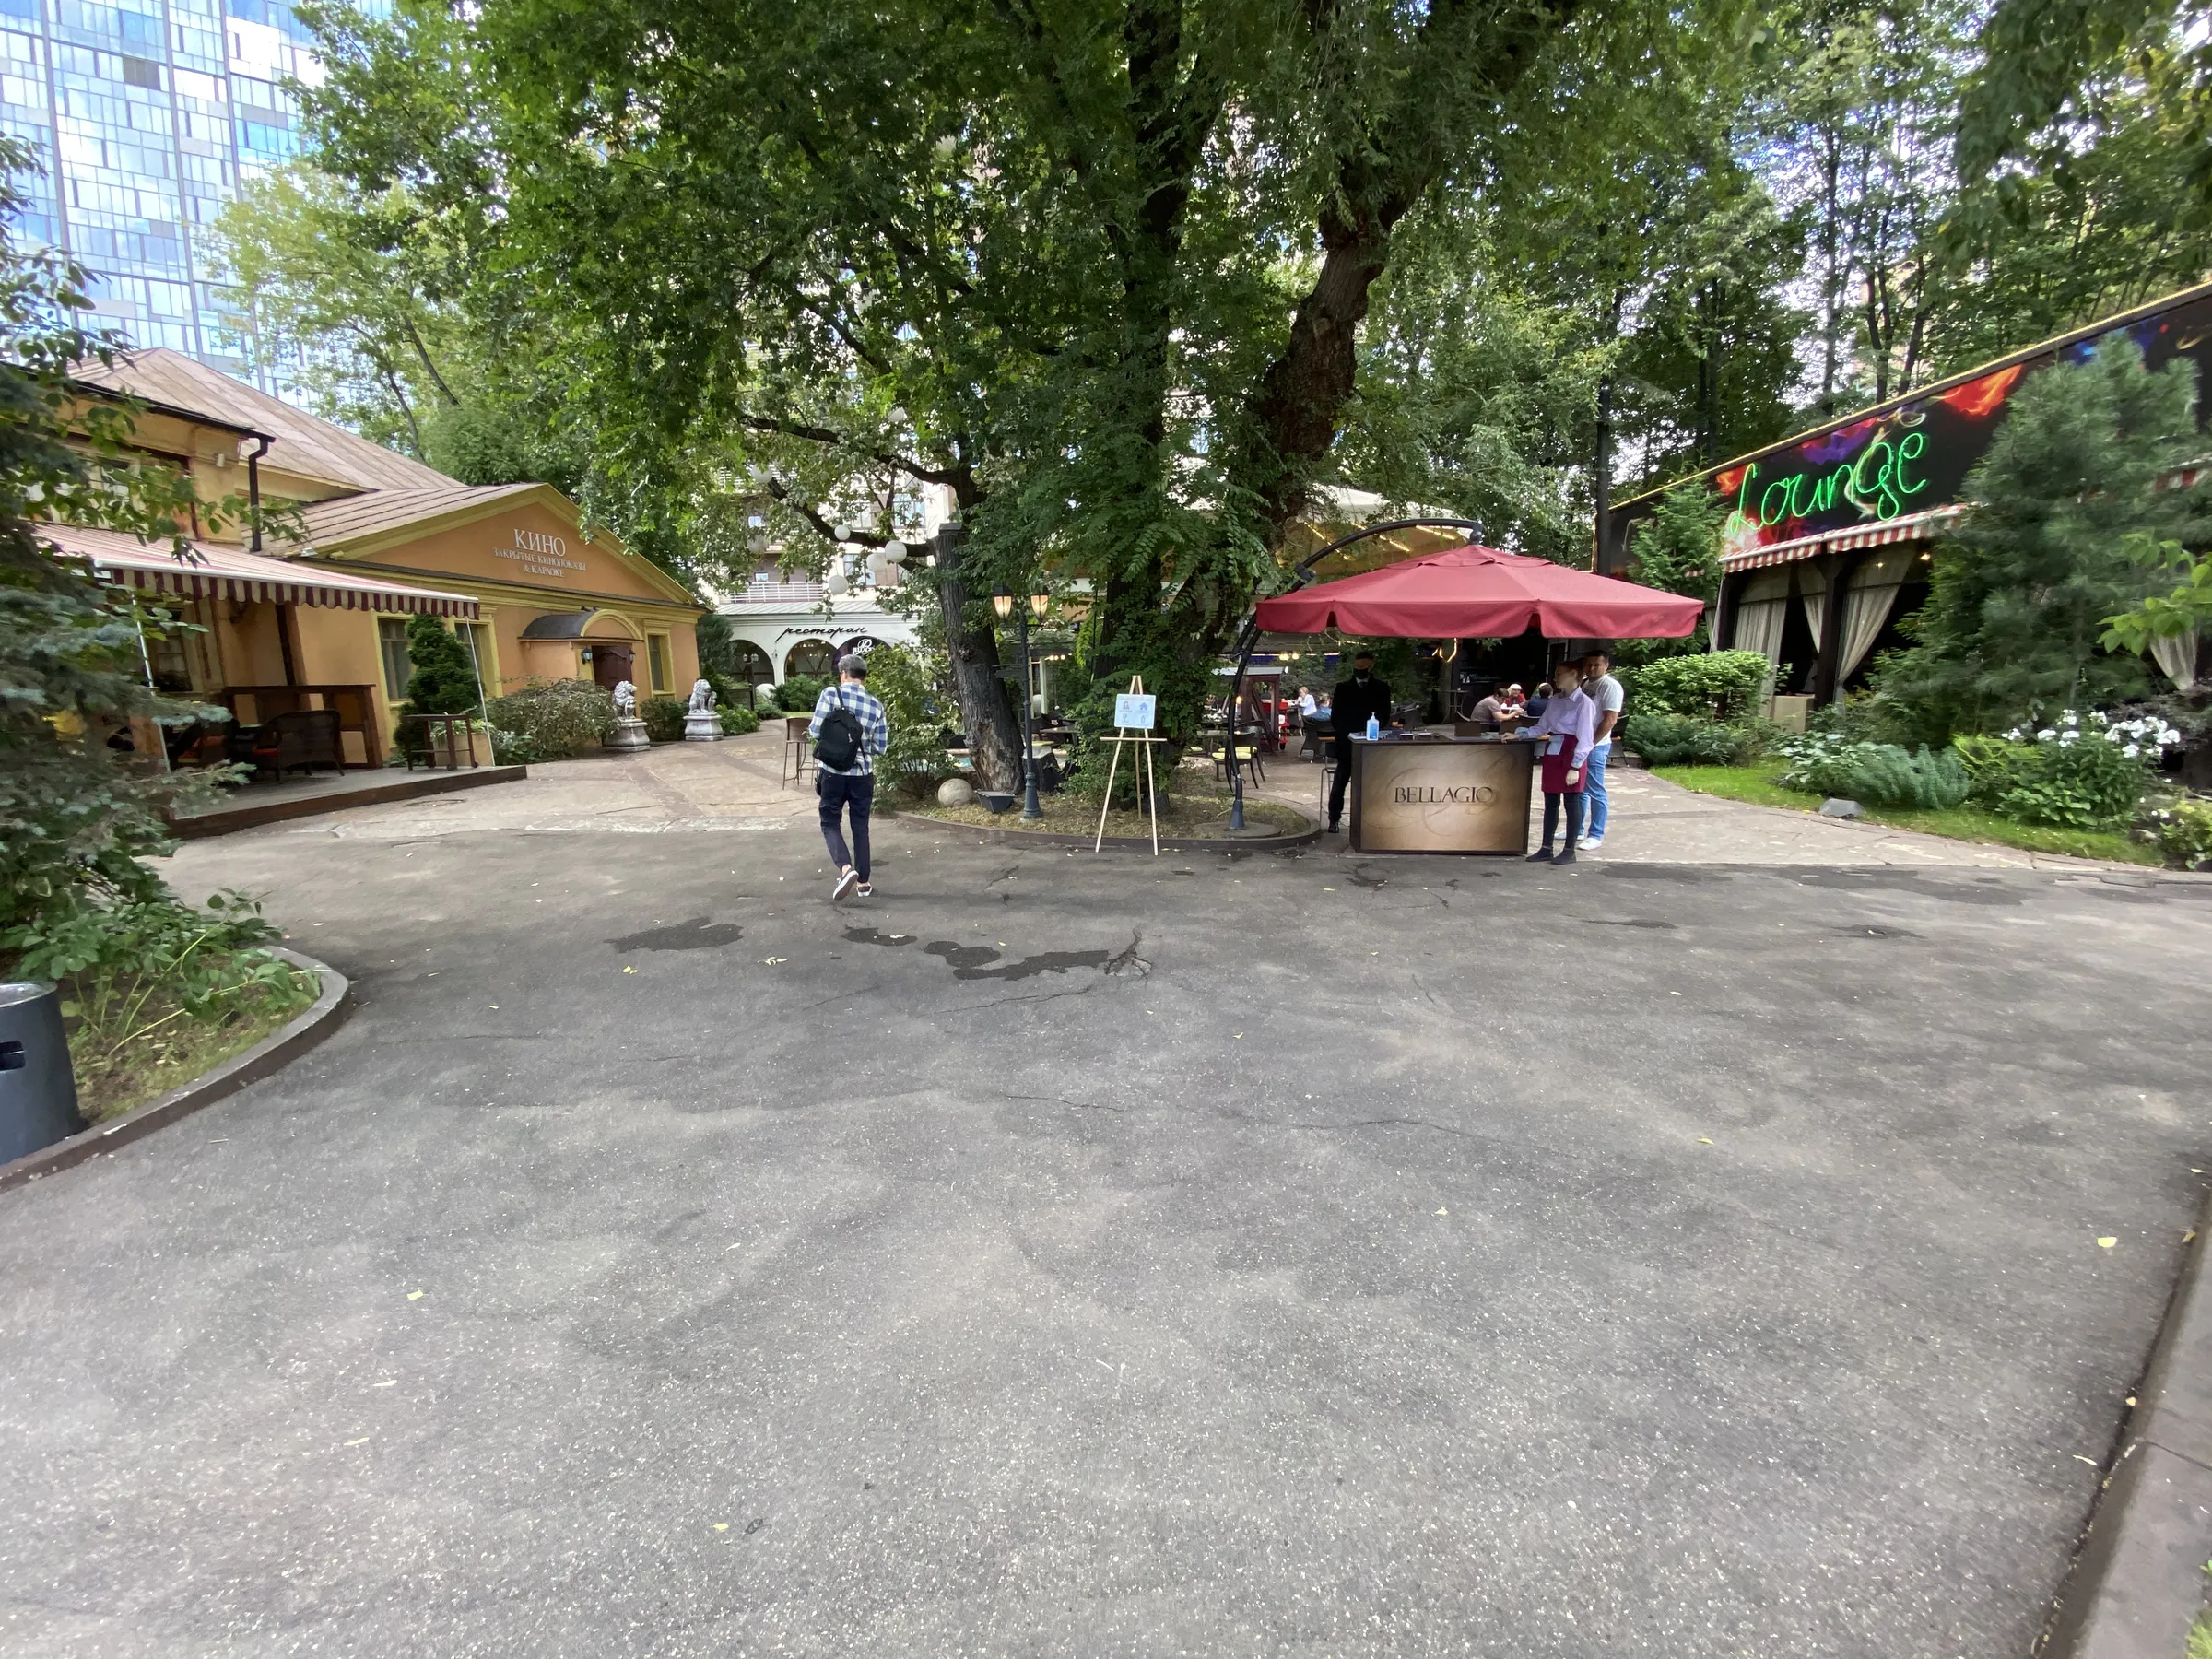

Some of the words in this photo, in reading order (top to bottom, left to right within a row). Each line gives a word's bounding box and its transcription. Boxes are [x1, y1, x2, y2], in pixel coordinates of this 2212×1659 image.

[1729, 432, 1927, 535] Lounge
[513, 529, 566, 557] КИНО
[493, 547, 536, 563] ЗАКРЫТЫЕ
[537, 555, 587, 571] КИНОПОКАЗЫ
[524, 564, 531, 573] &
[531, 564, 565, 578] КАРАОКЕ
[775, 627, 868, 643] ресторан
[1394, 786, 1494, 804] BELLAGIO
